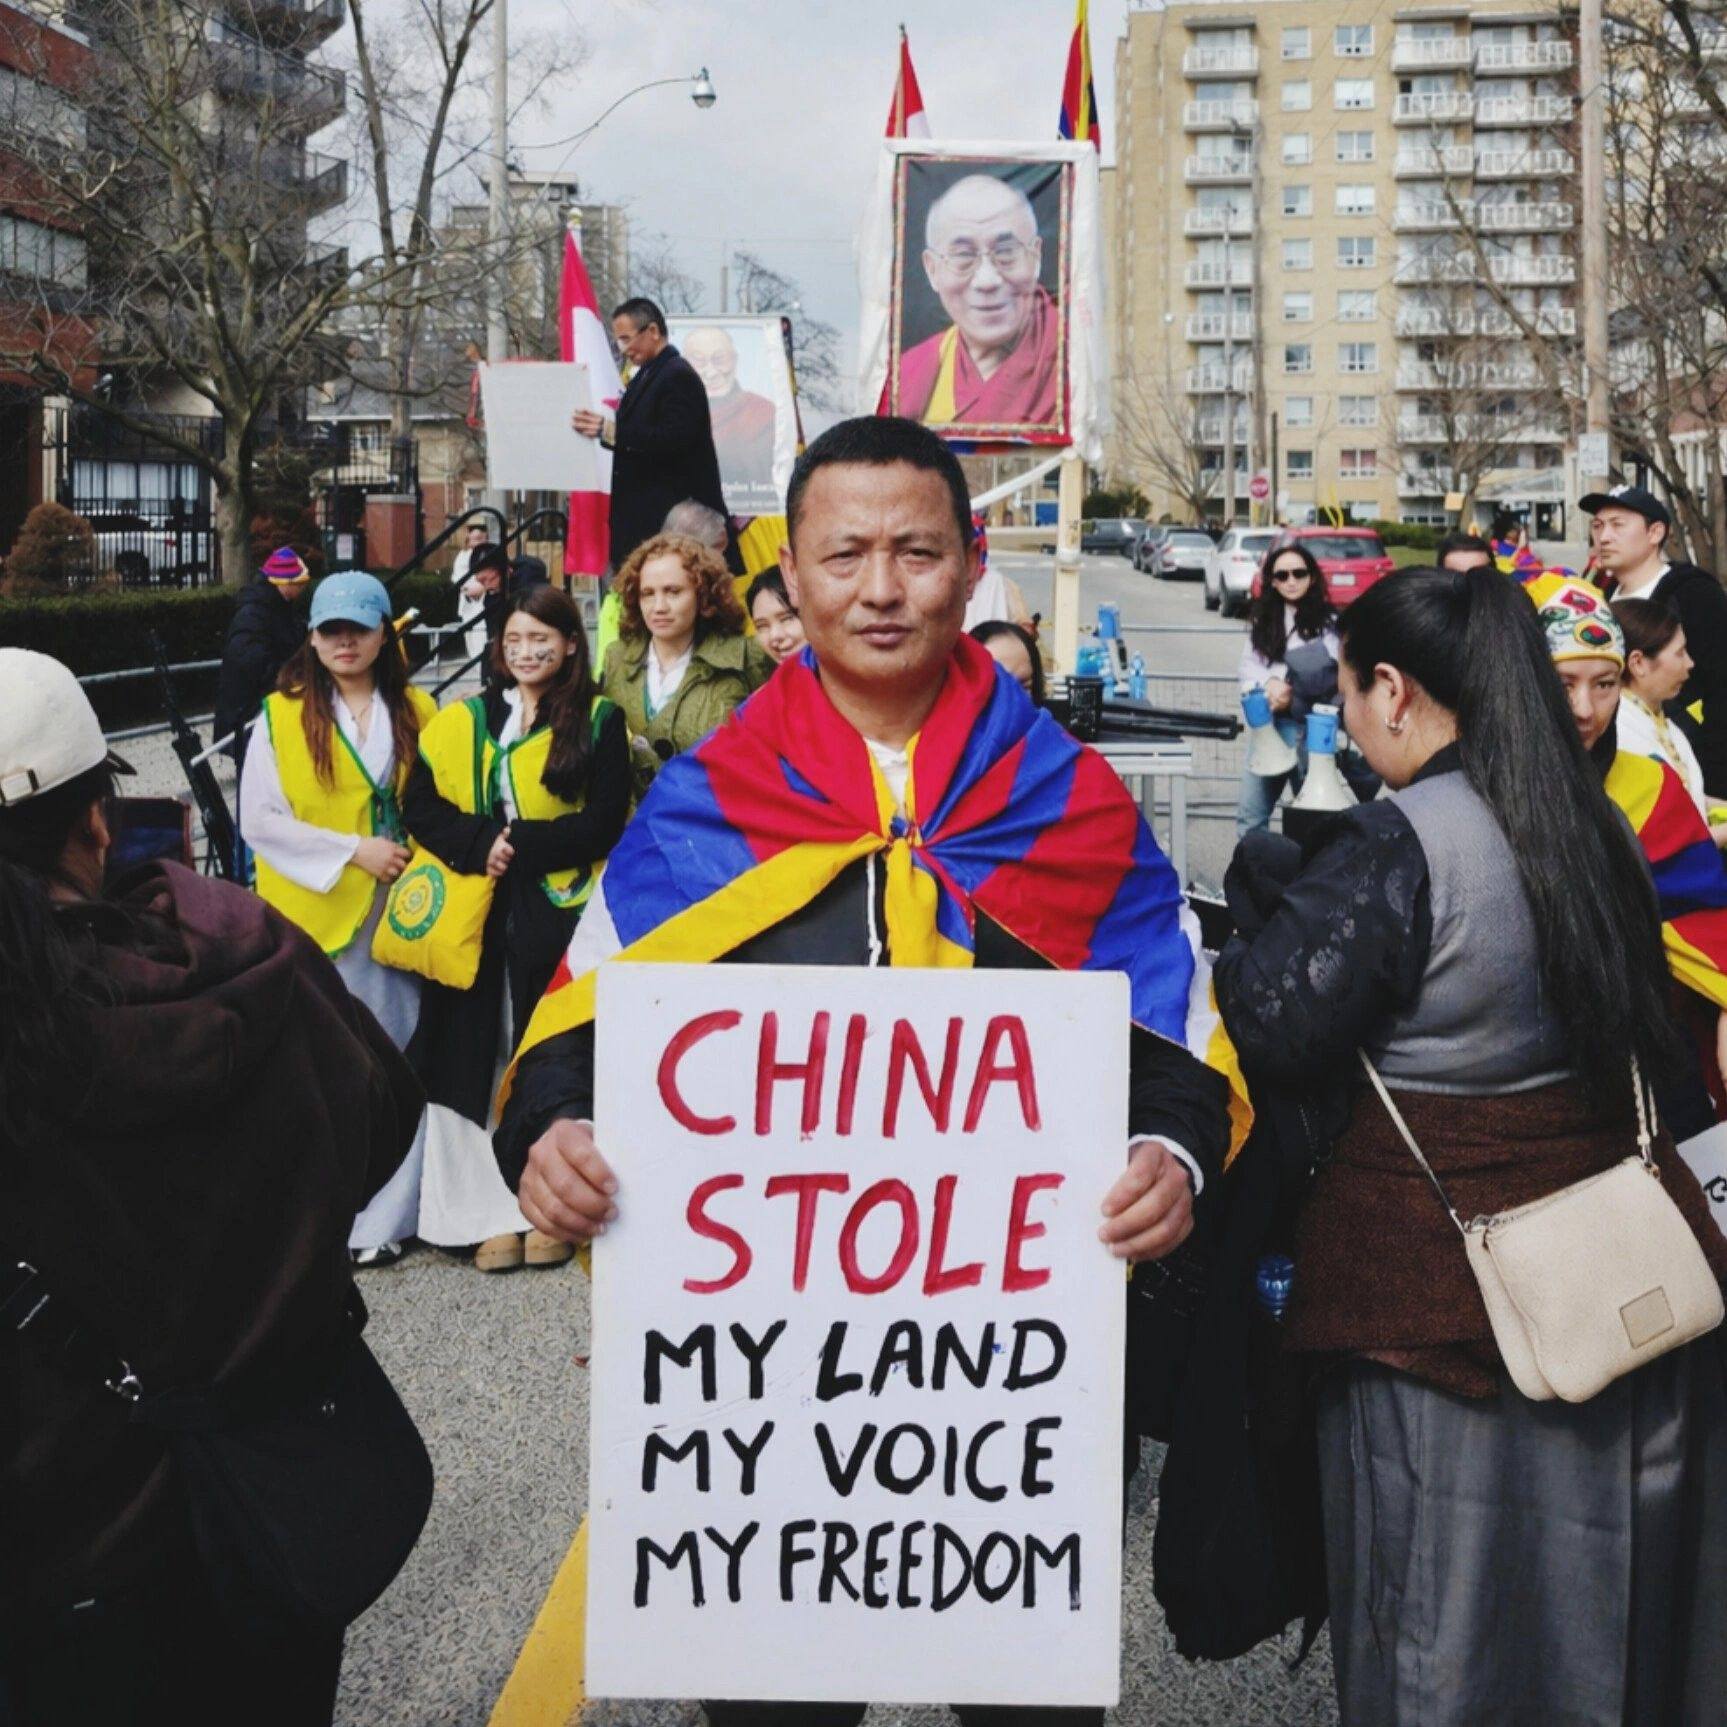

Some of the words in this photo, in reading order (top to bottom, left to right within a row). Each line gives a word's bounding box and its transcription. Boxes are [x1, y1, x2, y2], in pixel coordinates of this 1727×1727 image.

[657, 1010, 1041, 1139] CHINA
[683, 1173, 1066, 1297] STOLE
[644, 1319, 788, 1405] MY
[815, 1319, 1068, 1402] LAND
[641, 1420, 775, 1496] MY
[814, 1416, 1063, 1503] VOICE
[633, 1520, 760, 1609] MY
[779, 1518, 1081, 1612] FREEDOM
